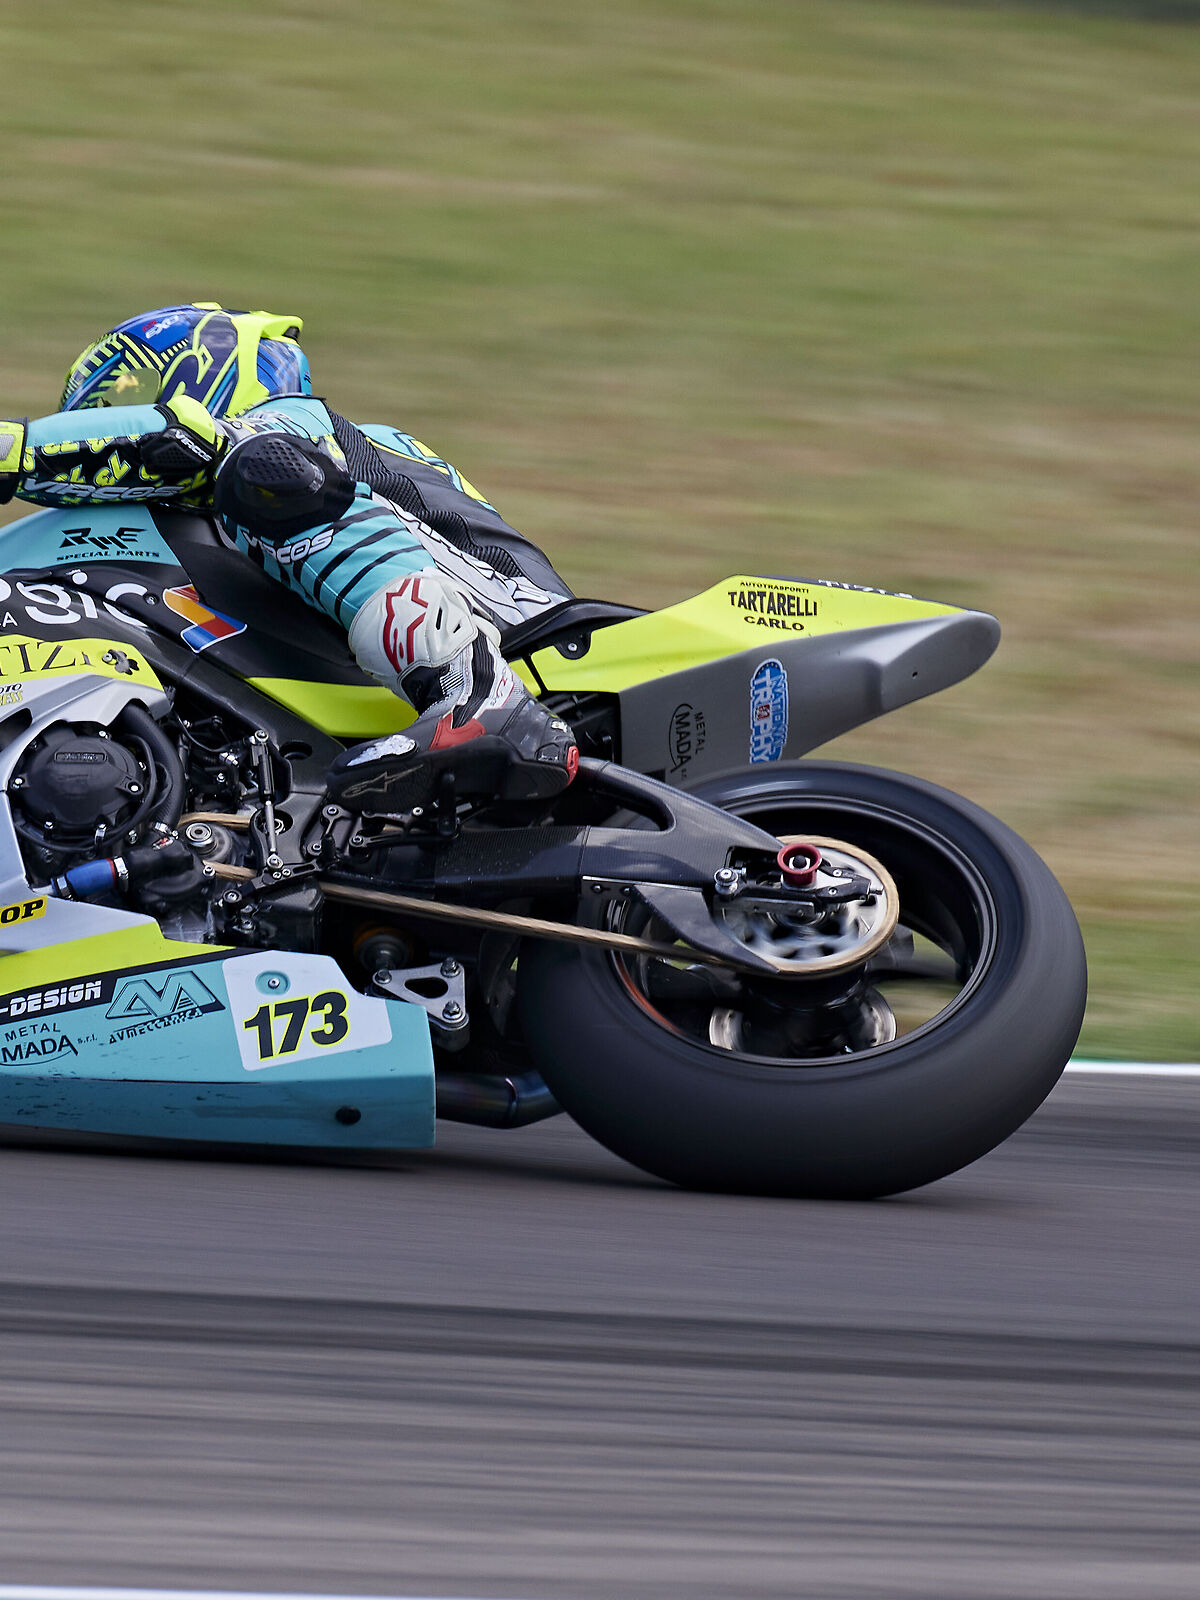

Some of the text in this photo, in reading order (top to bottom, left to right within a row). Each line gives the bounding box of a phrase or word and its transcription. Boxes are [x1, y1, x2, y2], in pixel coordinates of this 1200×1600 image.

[175, 429, 212, 462] VIRCOS
[24, 477, 186, 499] VIRCOS
[56, 550, 160, 561] SPECIAL PARTS
[740, 581, 809, 593] AUTOTRASPORTI
[728, 591, 818, 617] TARTARELLI
[744, 616, 805, 631] CARLO
[670, 711, 692, 773] MADA
[694, 711, 706, 755] METAL
[5, 1022, 61, 1042] METAL
[243, 989, 350, 1060] 173
[1, 1033, 97, 1063] MADA s.r.l.
